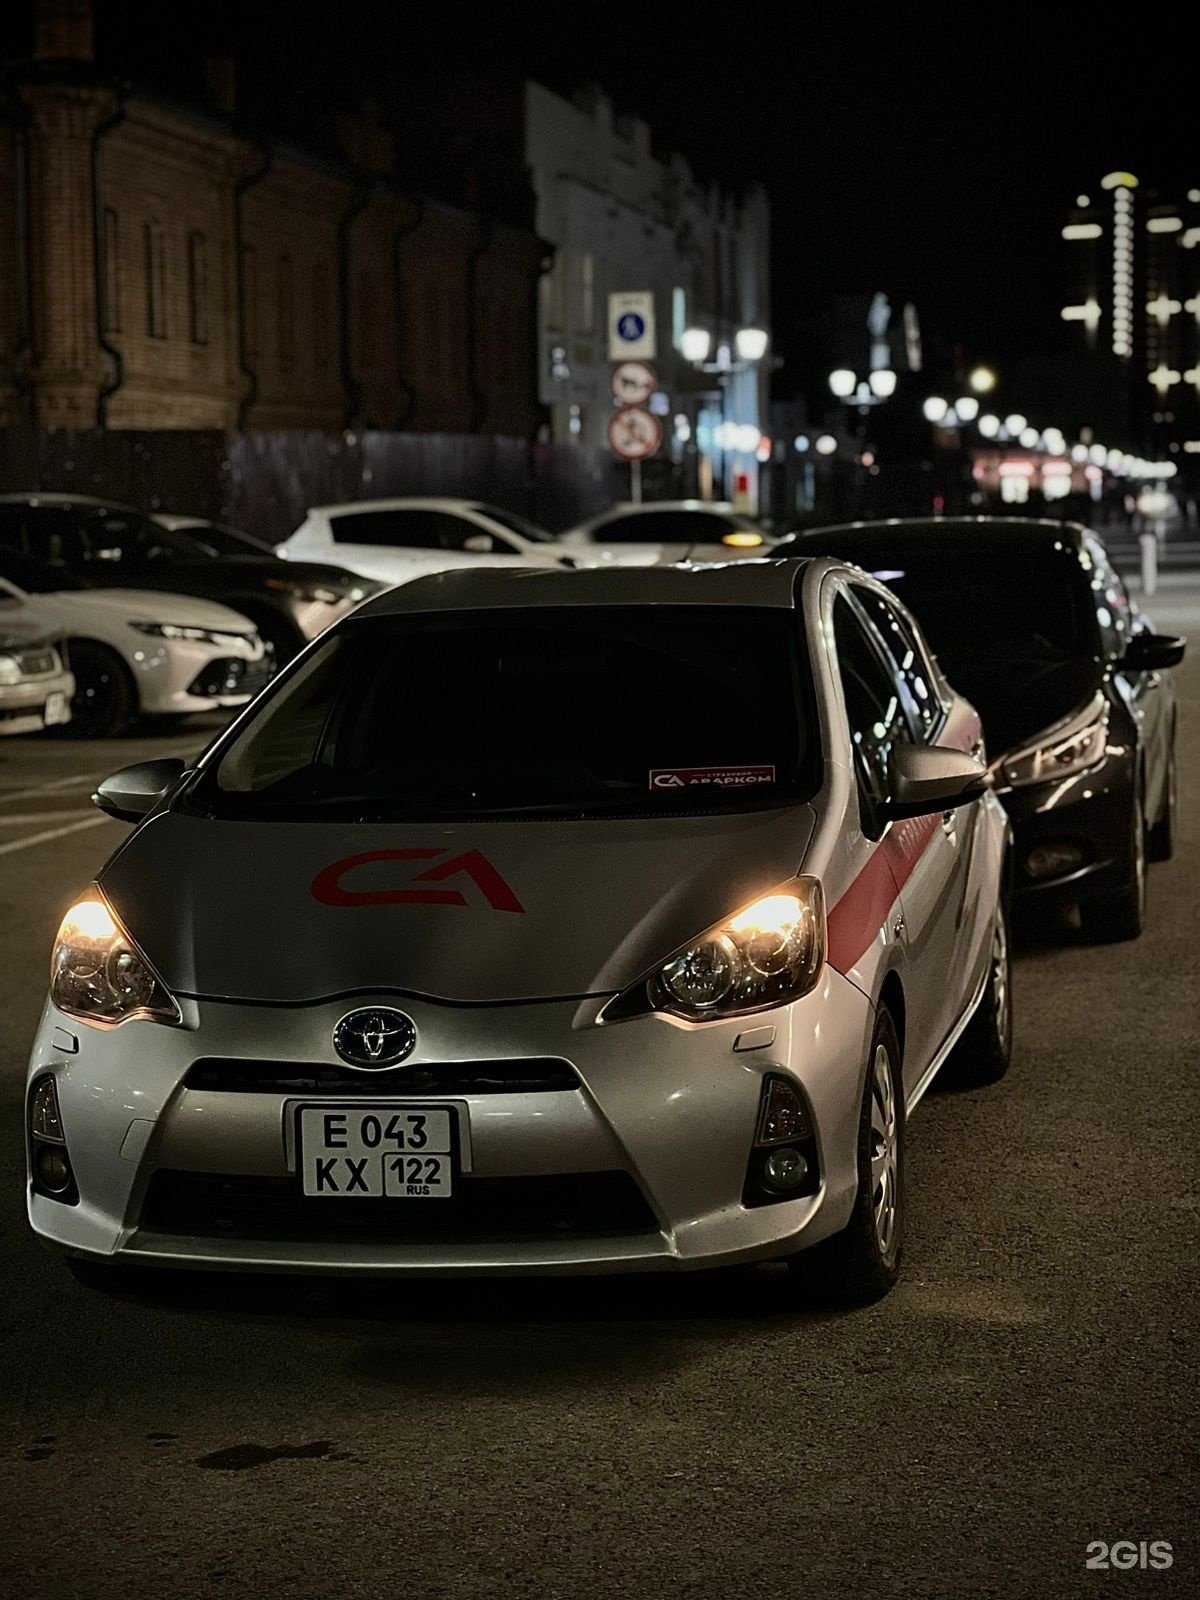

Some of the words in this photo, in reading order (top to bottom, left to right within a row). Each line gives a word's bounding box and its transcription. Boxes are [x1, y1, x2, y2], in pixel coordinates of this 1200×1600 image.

[323, 1114, 348, 1148] E
[360, 1114, 428, 1149] 043
[315, 1157, 370, 1192] KX
[389, 1157, 441, 1185] 122
[406, 1184, 431, 1196] RUS
